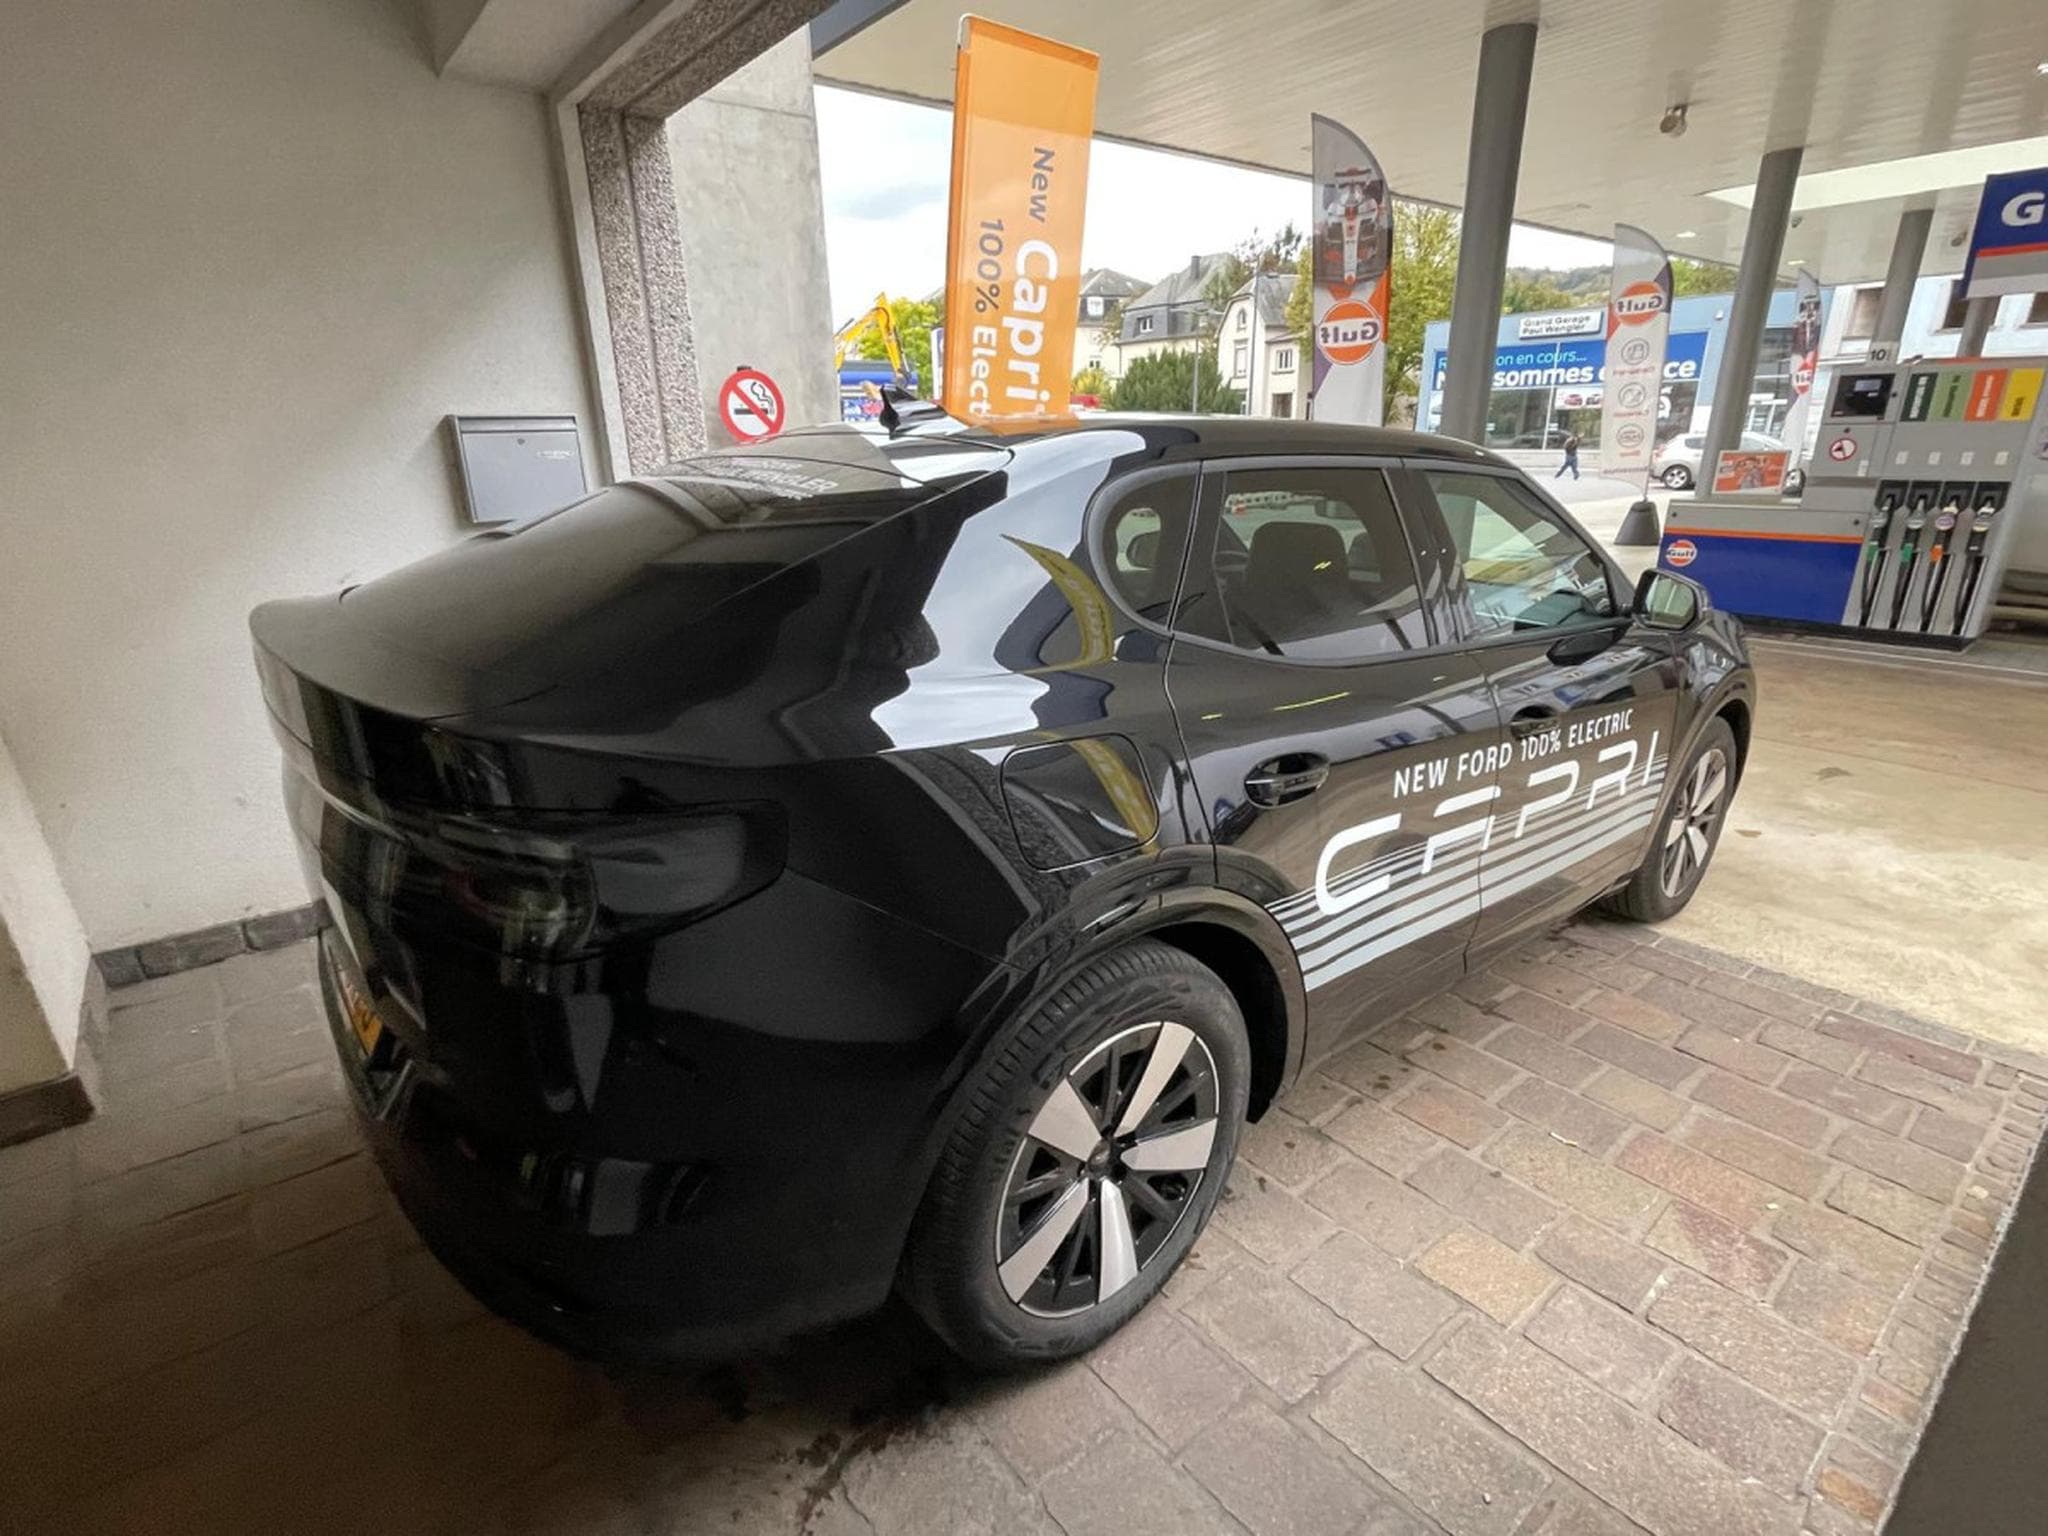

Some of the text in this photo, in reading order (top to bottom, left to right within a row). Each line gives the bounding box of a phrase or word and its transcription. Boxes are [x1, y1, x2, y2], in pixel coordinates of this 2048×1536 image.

[975, 218, 1004, 313] 100%
[1002, 147, 1058, 402] New Capri
[1554, 315, 1590, 325] Garage
[1492, 365, 1594, 387] sommes
[1516, 353, 1534, 365] en
[1871, 348, 1887, 361] 10
[1393, 708, 1634, 798] NEW FORD 100% ELECTRIC
[1315, 730, 1660, 915] CAPRI
